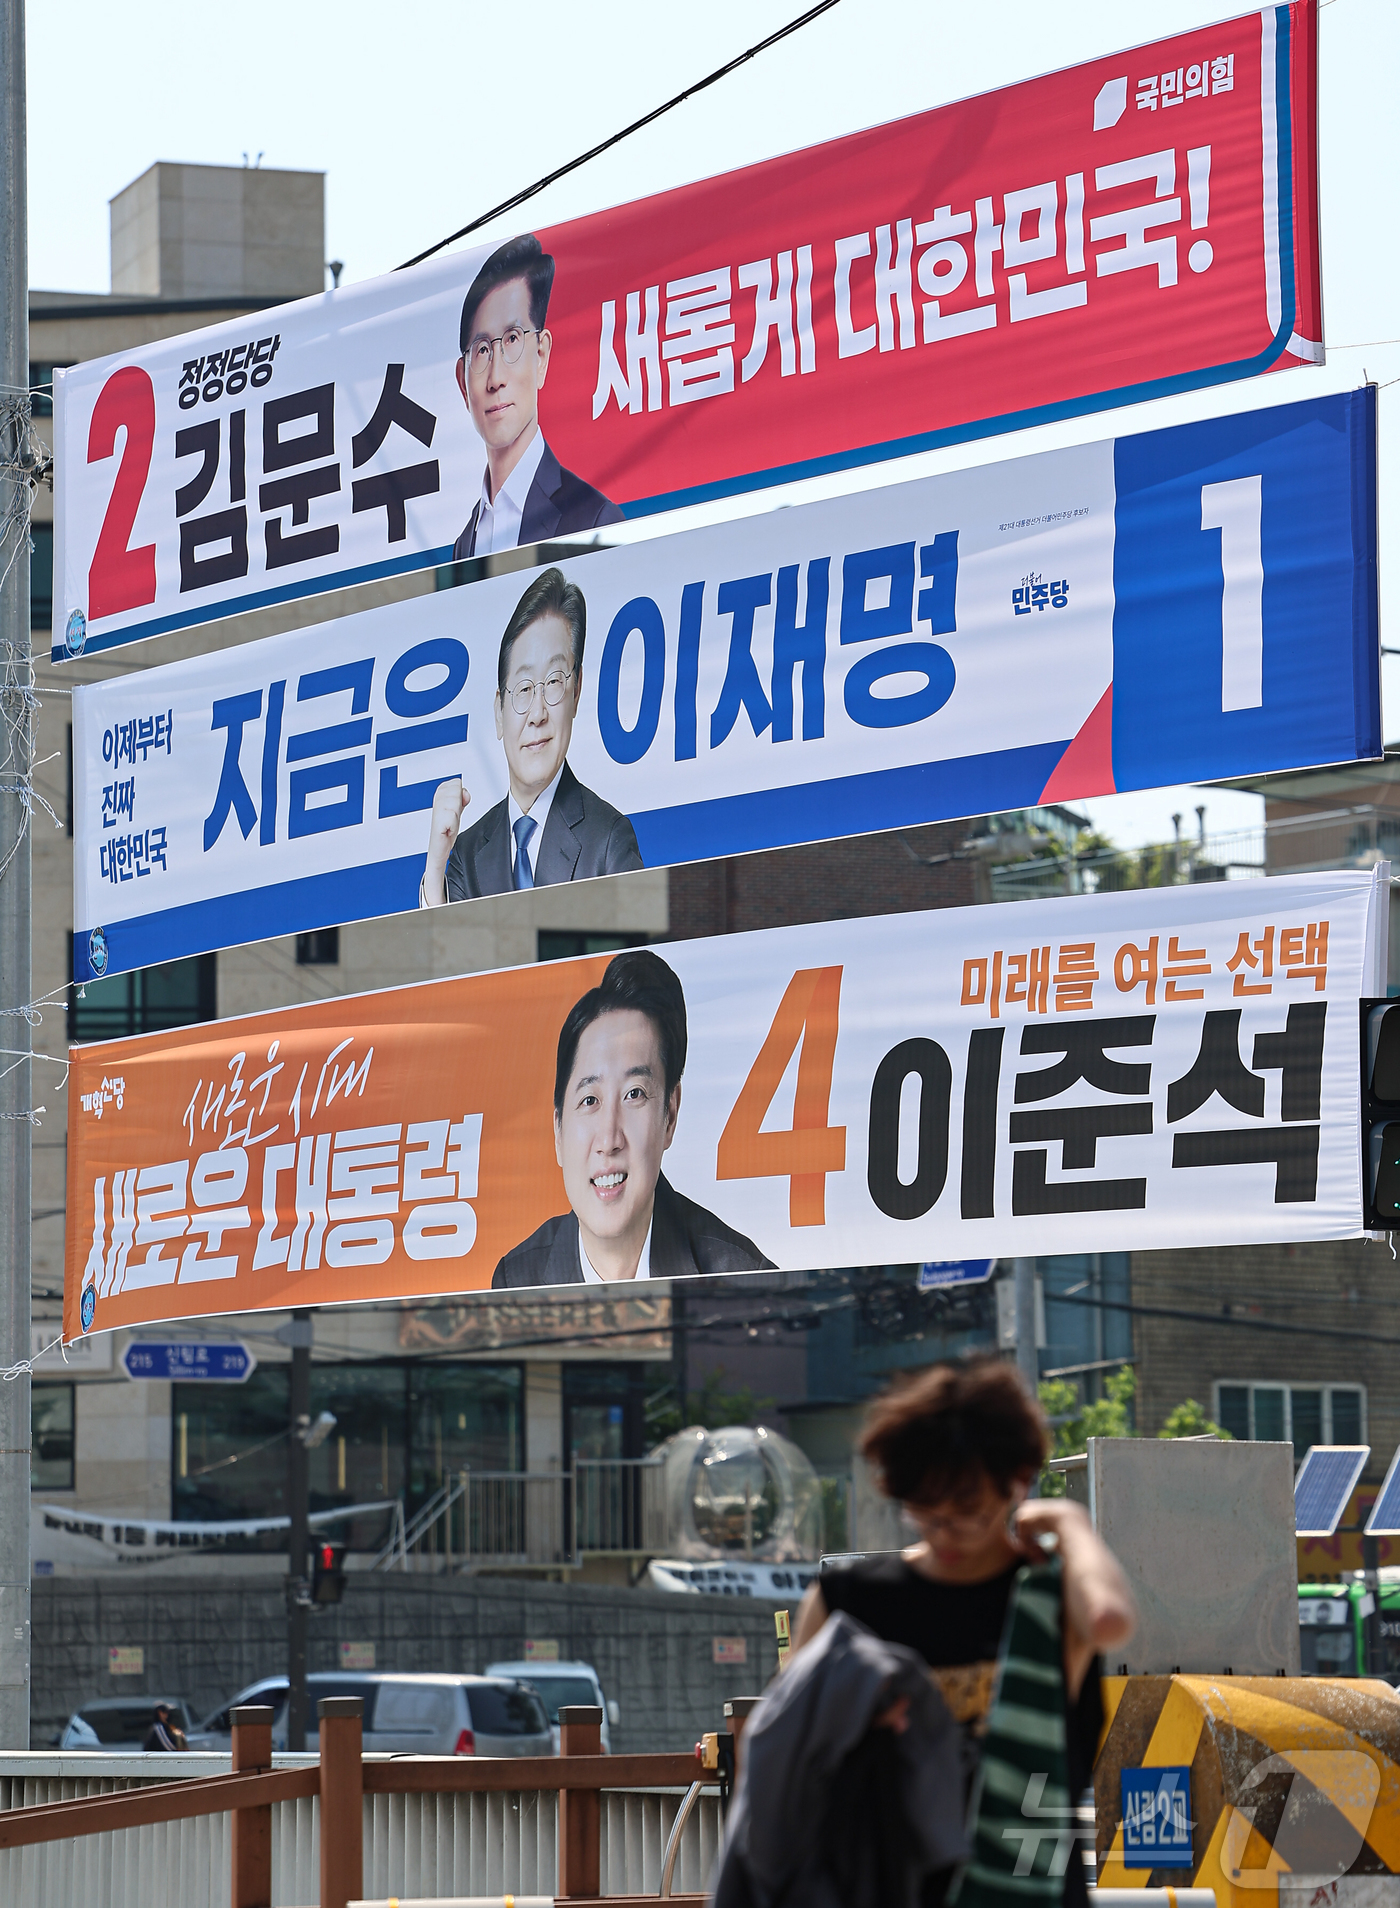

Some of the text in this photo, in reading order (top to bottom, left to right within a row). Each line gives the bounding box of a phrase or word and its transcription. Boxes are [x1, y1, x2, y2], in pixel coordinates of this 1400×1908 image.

[1134, 53, 1236, 112] 국민의힘
[592, 144, 1214, 421] 새롭게 대한민국!
[177, 333, 281, 411] 정정당당
[86, 365, 157, 622] 2
[174, 362, 441, 594] 김문수
[998, 507, 1089, 531] 제21대 대통령선거 더불어민주당 후보자
[1011, 579, 1070, 616] 민주당
[1020, 571, 1042, 587] 더불어
[1200, 474, 1265, 713] 1
[202, 528, 960, 853] 지금은 이재명
[101, 708, 174, 770] 이제부터
[100, 776, 136, 829] 진짜
[99, 826, 169, 884] 대한민국
[959, 920, 1331, 1019] 미래를 여는 선택
[80, 1075, 126, 1120] 개혁신당
[182, 1039, 285, 1151] 새로운
[715, 964, 1329, 1228] 4 이준석
[81, 1112, 484, 1300] 새로운 대통령
[129, 1354, 153, 1369] 215
[1125, 1789, 1190, 1847] 신림2교
